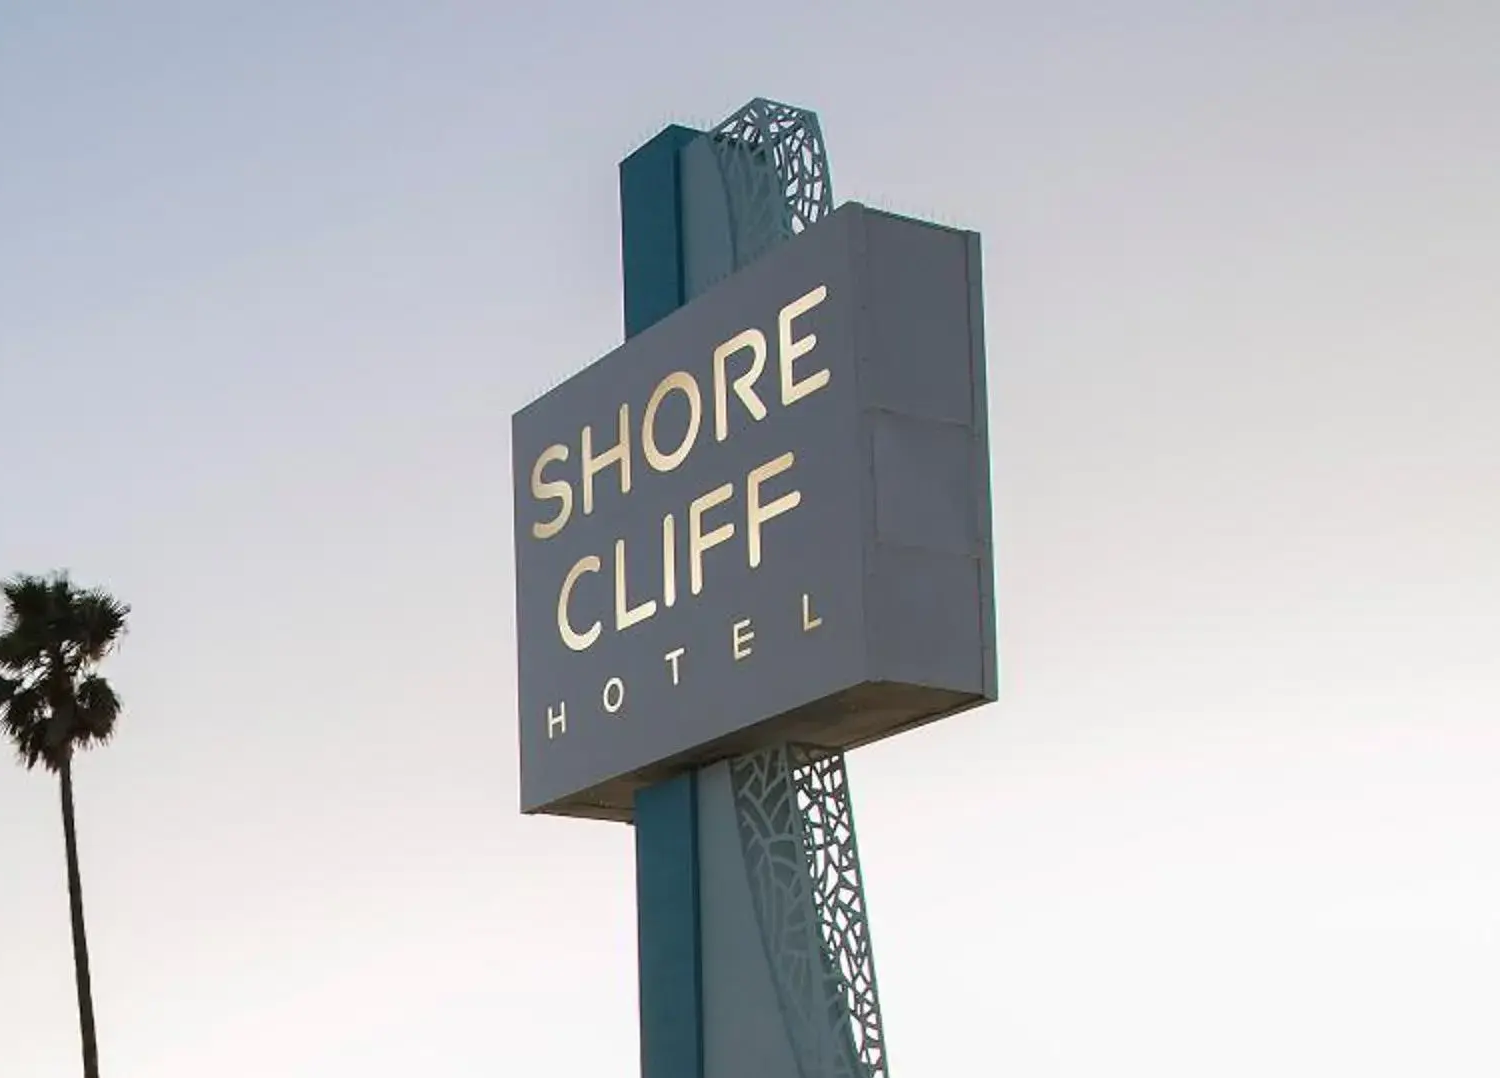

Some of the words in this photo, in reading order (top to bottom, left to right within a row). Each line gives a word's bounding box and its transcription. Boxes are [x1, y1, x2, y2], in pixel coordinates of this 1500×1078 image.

[530, 285, 831, 539] SHORE
[557, 451, 801, 651] CLIFF
[547, 593, 823, 739] HOTEL
